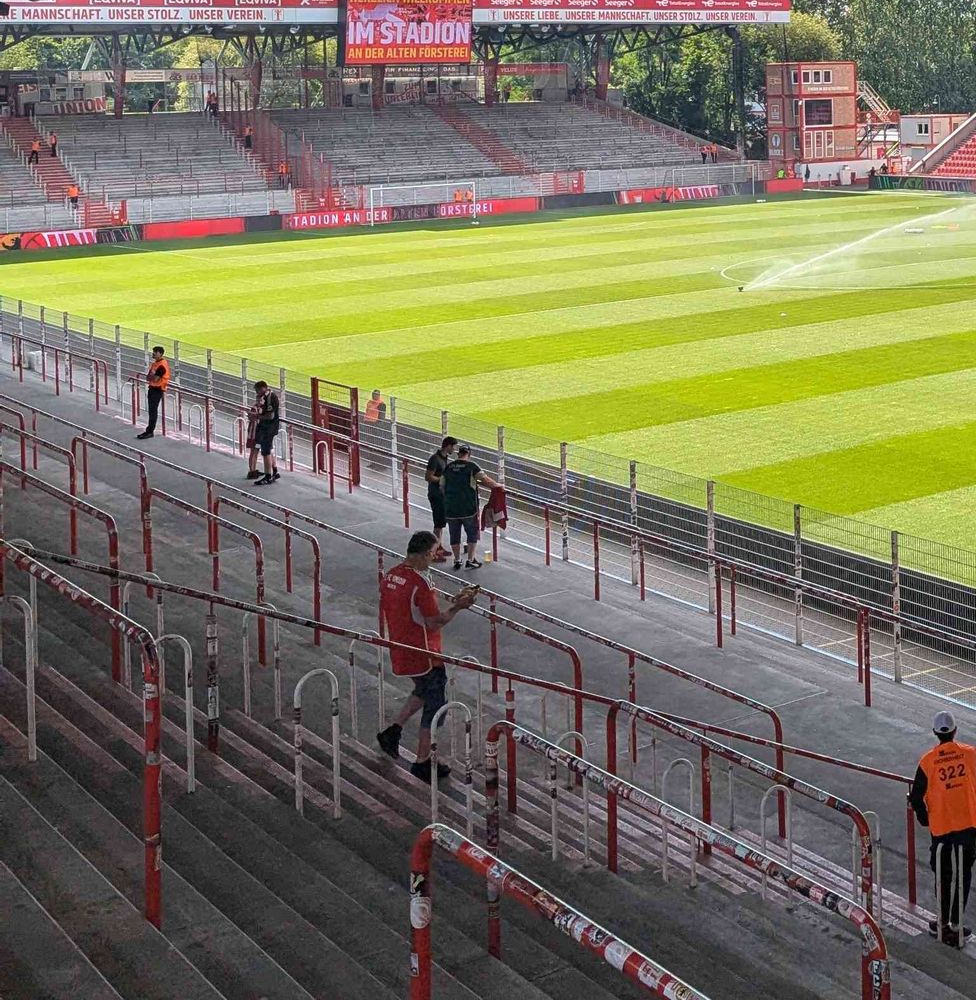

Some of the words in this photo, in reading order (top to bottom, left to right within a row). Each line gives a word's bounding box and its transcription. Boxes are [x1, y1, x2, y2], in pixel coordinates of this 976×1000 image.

[604, 0, 628, 7] Seeger
[21, 9, 104, 20] MANNSCHAFT.
[108, 9, 144, 20] UNSER
[148, 9, 183, 20] STOLZ.
[190, 10, 223, 20] UNSER
[227, 10, 266, 20] VEREIN.
[503, 10, 535, 20] UNSERE
[538, 11, 562, 20] LIEBE.
[566, 11, 596, 20] UNSERE
[598, 11, 651, 21] MANNSCHAFT.
[654, 11, 677, 21] UNSER
[680, 11, 703, 21] STOLZ.
[706, 12, 729, 21] UNSER
[731, 12, 757, 21] VEREIN.
[348, 21, 374, 45] IM
[380, 21, 469, 44] STADION
[348, 47, 362, 58] AN
[365, 47, 384, 58] DER
[387, 47, 417, 58] ALTEN
[52, 96, 107, 115] UNION
[344, 212, 360, 223] AN
[366, 210, 388, 221] DER
[938, 763, 966, 781] 322
